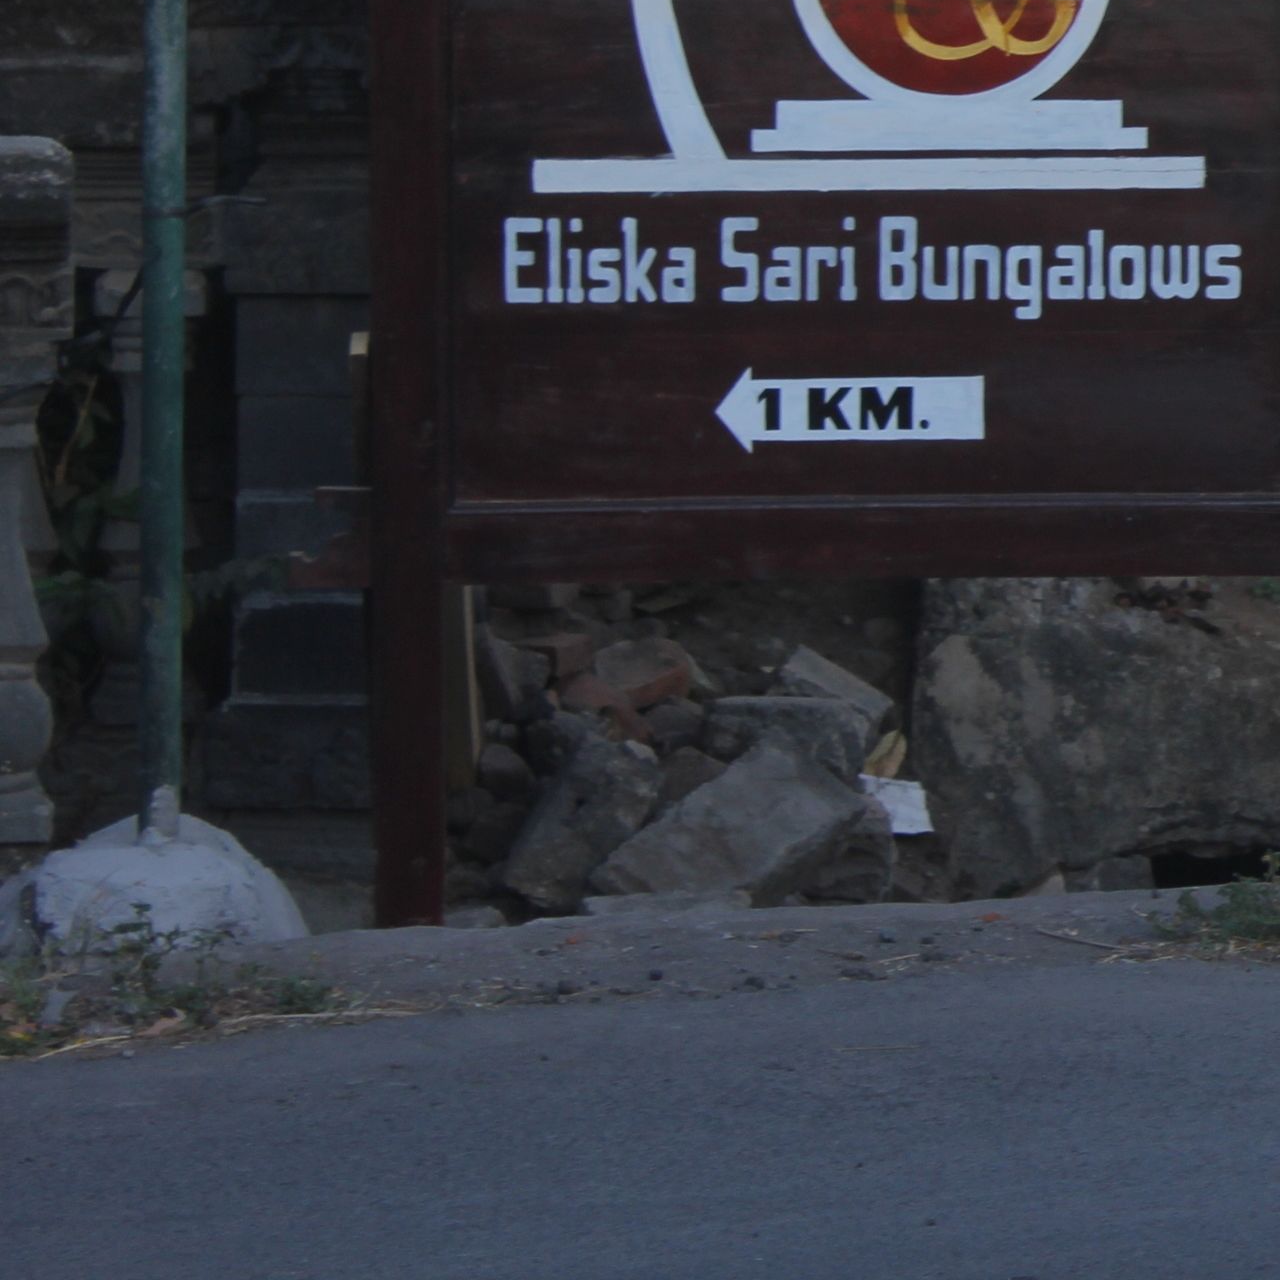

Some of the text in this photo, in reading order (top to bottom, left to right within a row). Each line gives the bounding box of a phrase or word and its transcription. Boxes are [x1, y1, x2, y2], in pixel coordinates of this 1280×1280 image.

[504, 215, 1242, 320] Eliska Sari Bungalows
[757, 385, 930, 431] 1 KM.
